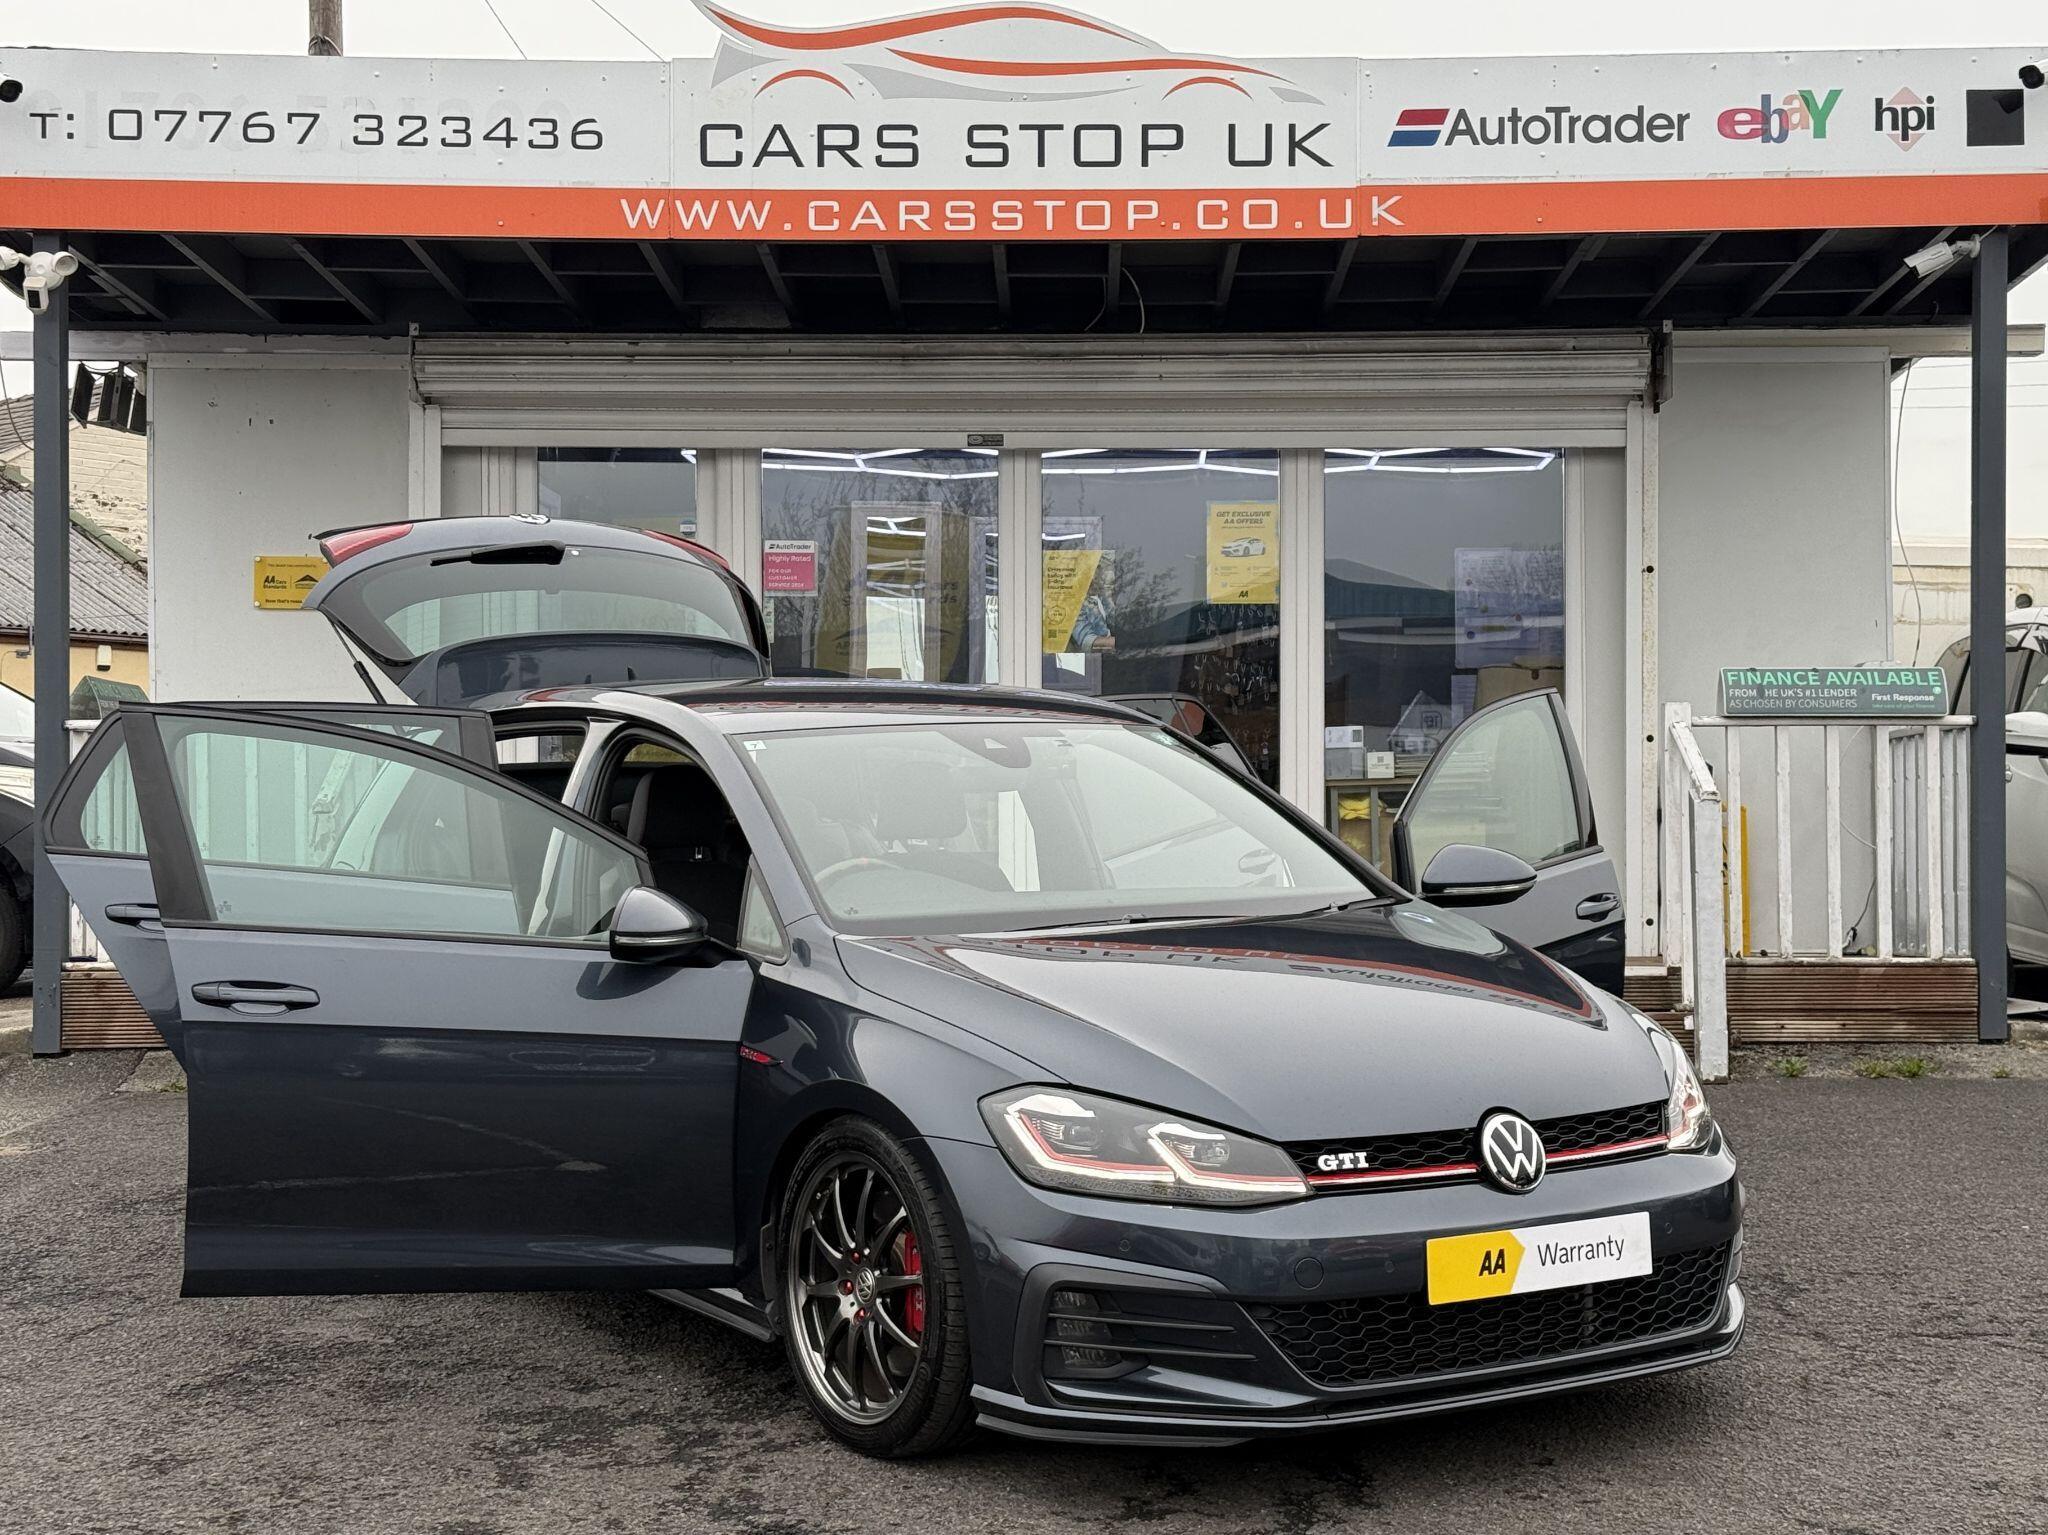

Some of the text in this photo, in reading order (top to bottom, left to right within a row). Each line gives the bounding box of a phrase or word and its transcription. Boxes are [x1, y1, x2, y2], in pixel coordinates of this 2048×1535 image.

[1444, 105, 1691, 146] AutoTrader
[1874, 95, 1936, 142] hpi
[29, 109, 604, 150] T: 07767 323436
[699, 123, 1333, 168] CARS STOP UK
[620, 194, 1406, 233] WWW.CARSSTOP.CO.UK
[775, 543, 812, 551] AutoTrader
[768, 554, 812, 564] Highly Rated
[1727, 671, 1942, 686] FINANCE AVAILABLE
[1729, 688, 1757, 697] FROM
[1780, 688, 1803, 697] UK'S
[1818, 688, 1858, 697] LENDER
[1871, 693, 1935, 703] First Response
[1729, 699, 1858, 709] AS CHOSEN BY CONSUMERS
[1317, 1151, 1370, 1171] GTI
[1478, 1234, 1625, 1277] AA Warranty
